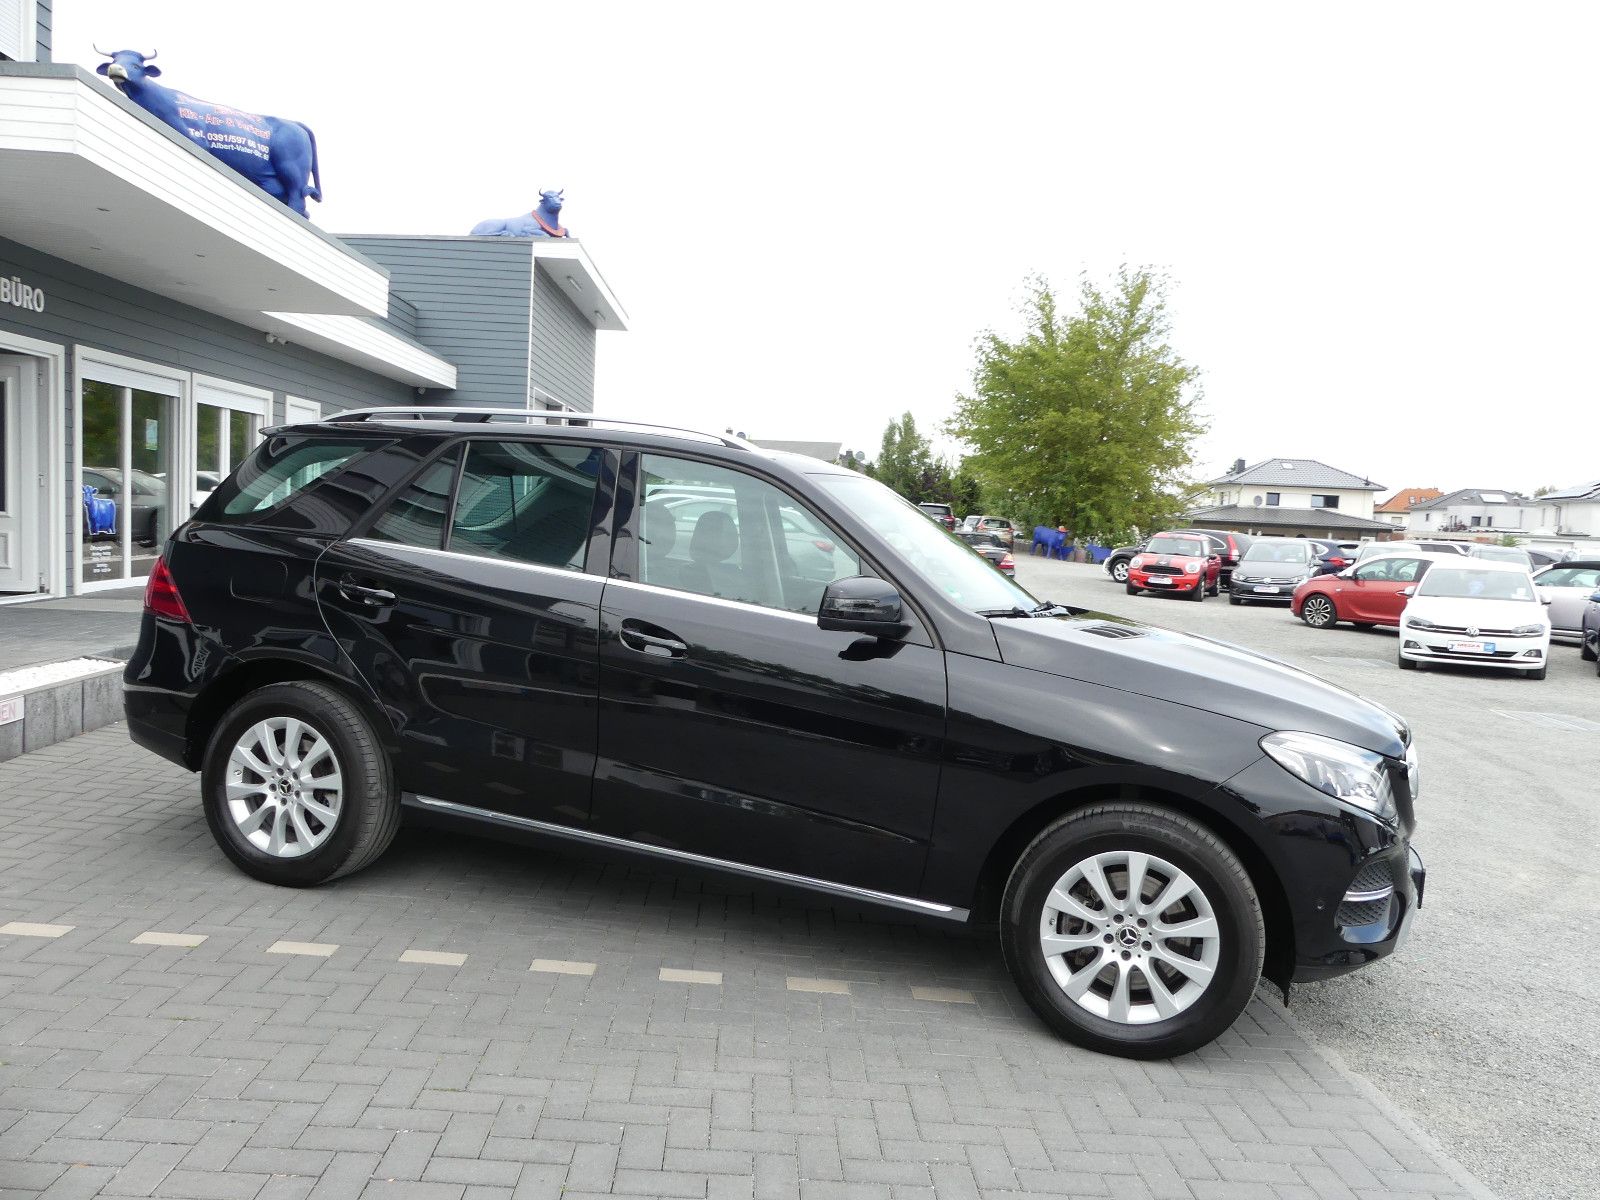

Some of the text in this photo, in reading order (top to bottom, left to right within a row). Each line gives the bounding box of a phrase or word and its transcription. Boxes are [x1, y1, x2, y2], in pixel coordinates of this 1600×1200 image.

[189, 128, 205, 138] Tel.
[0, 276, 45, 313] BÜRO
[0, 703, 16, 721] EN
